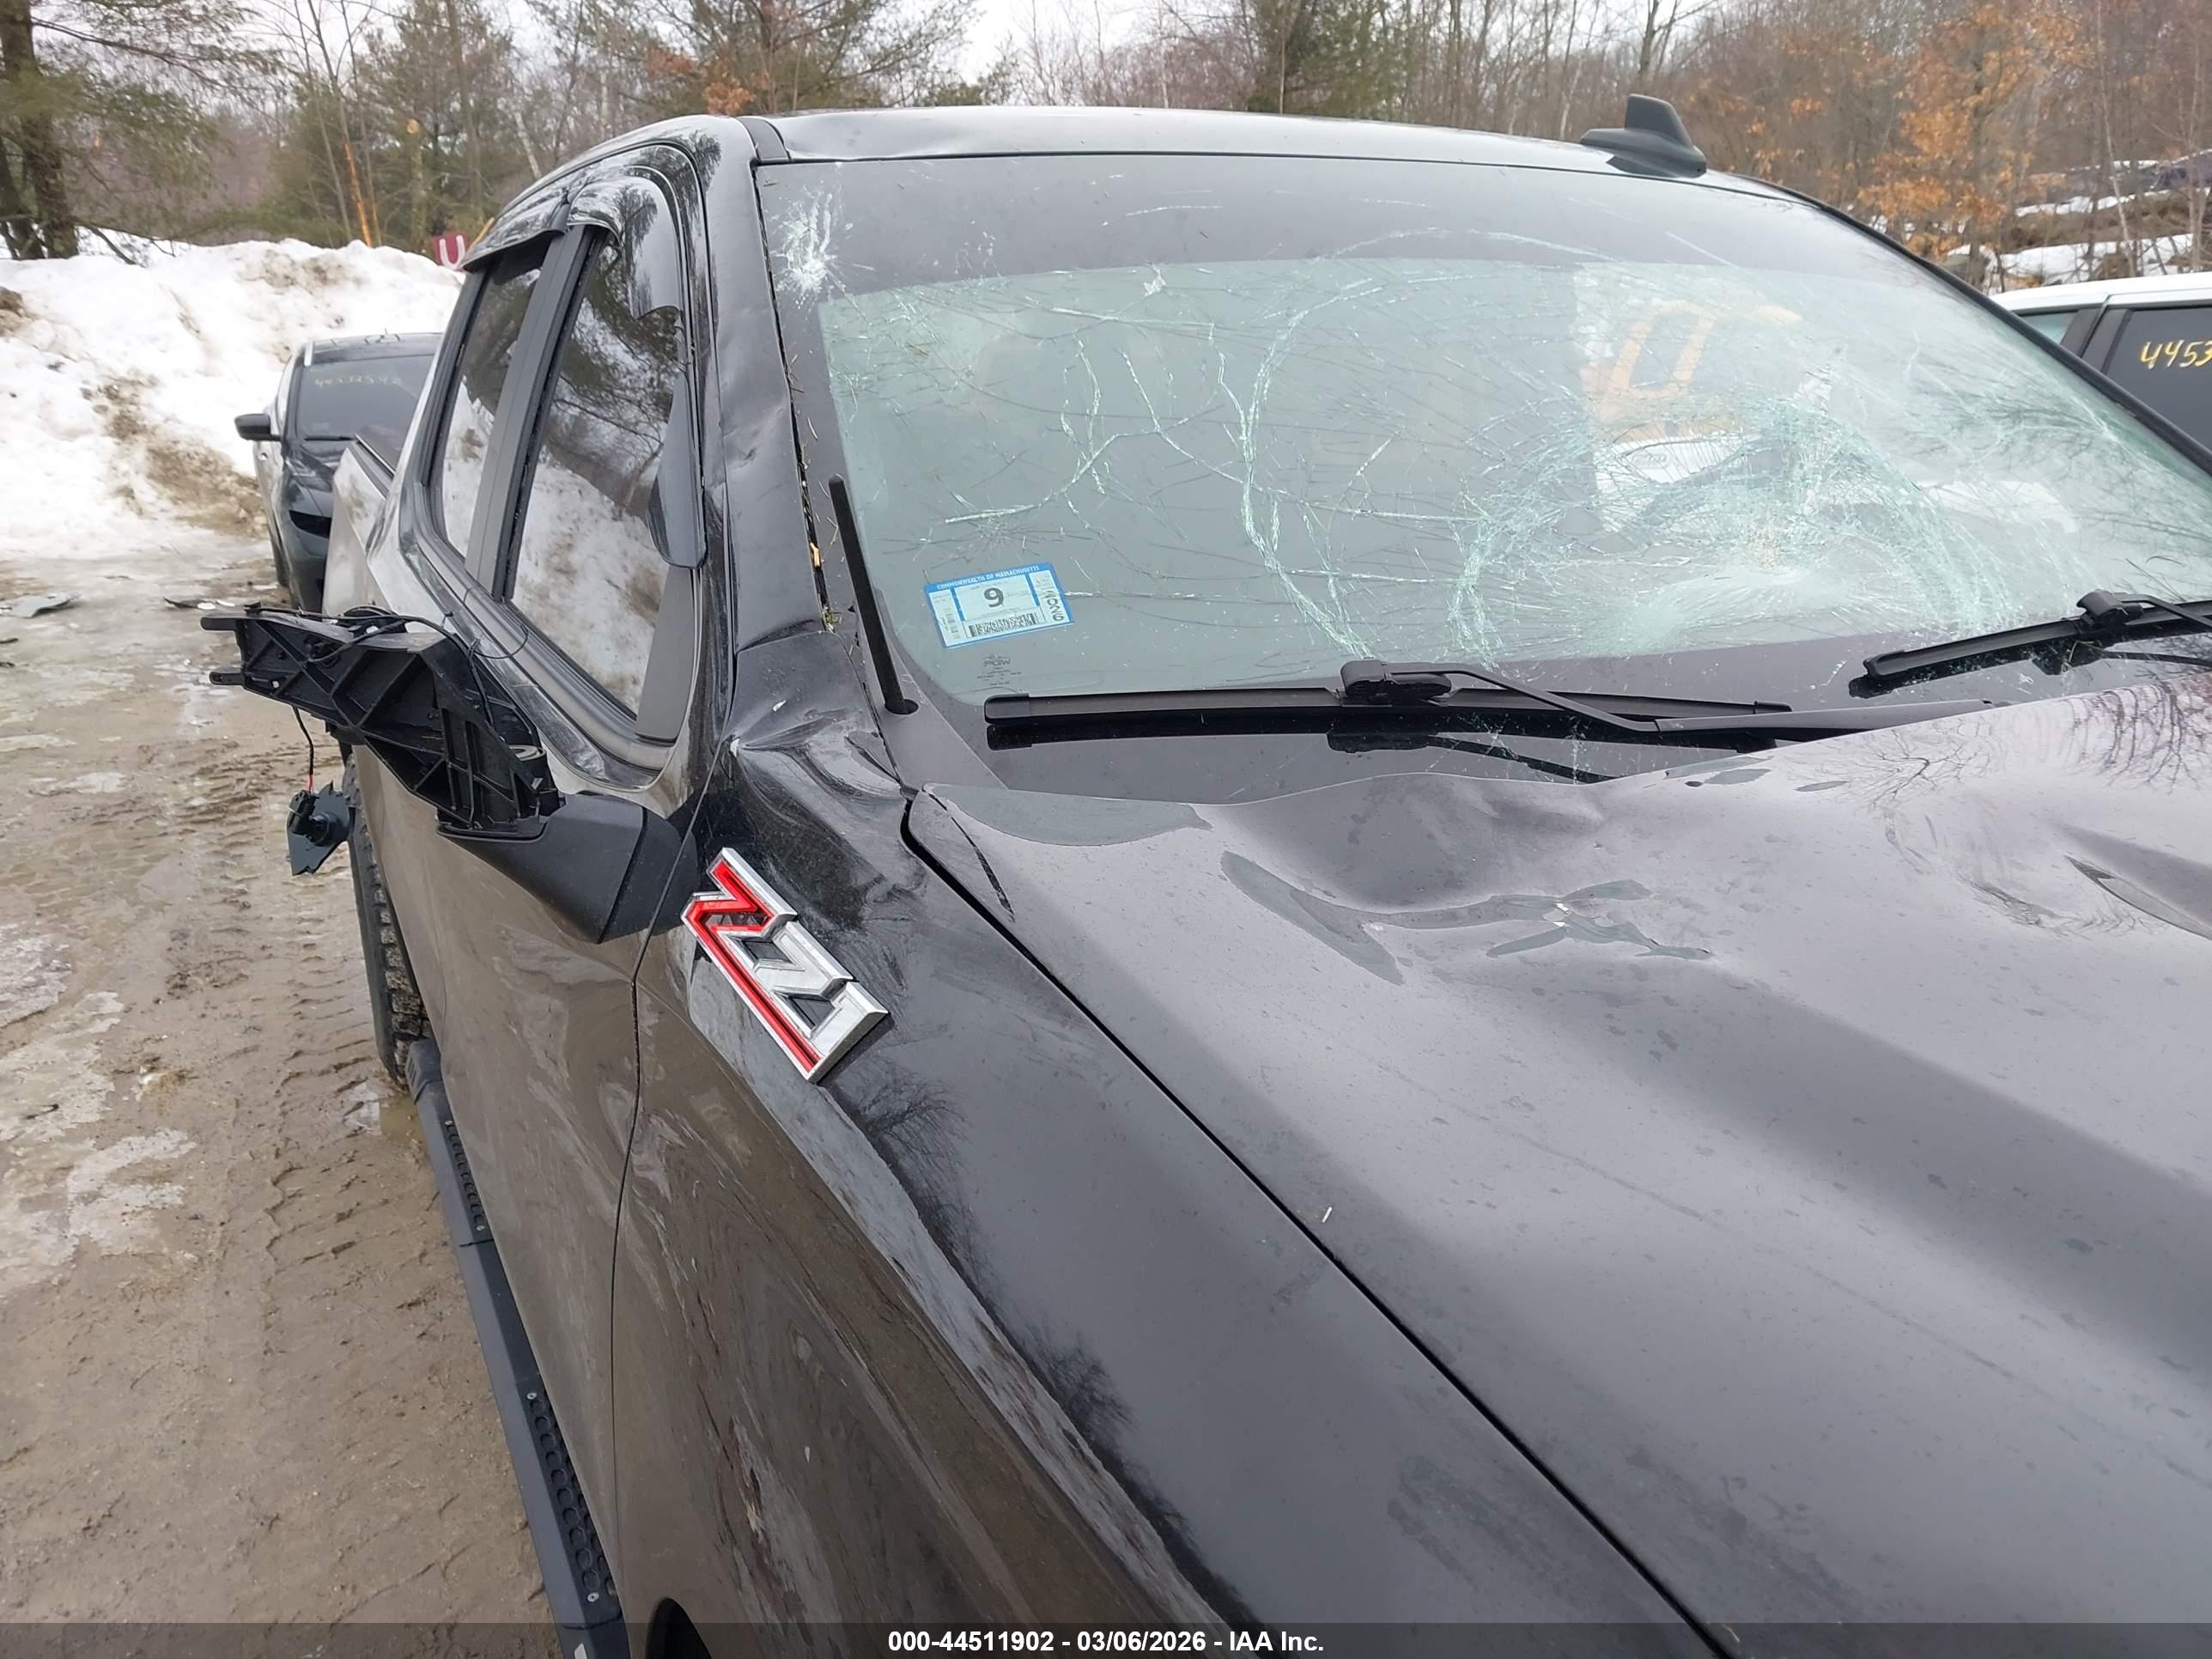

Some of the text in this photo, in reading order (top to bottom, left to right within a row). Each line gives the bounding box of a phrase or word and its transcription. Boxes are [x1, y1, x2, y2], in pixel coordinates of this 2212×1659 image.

[937, 576, 985, 590] COMMONWEALTH
[995, 566, 1040, 579] MASSACHUSETTS
[983, 586, 1005, 608] 9
[681, 847, 890, 1083] Z71
